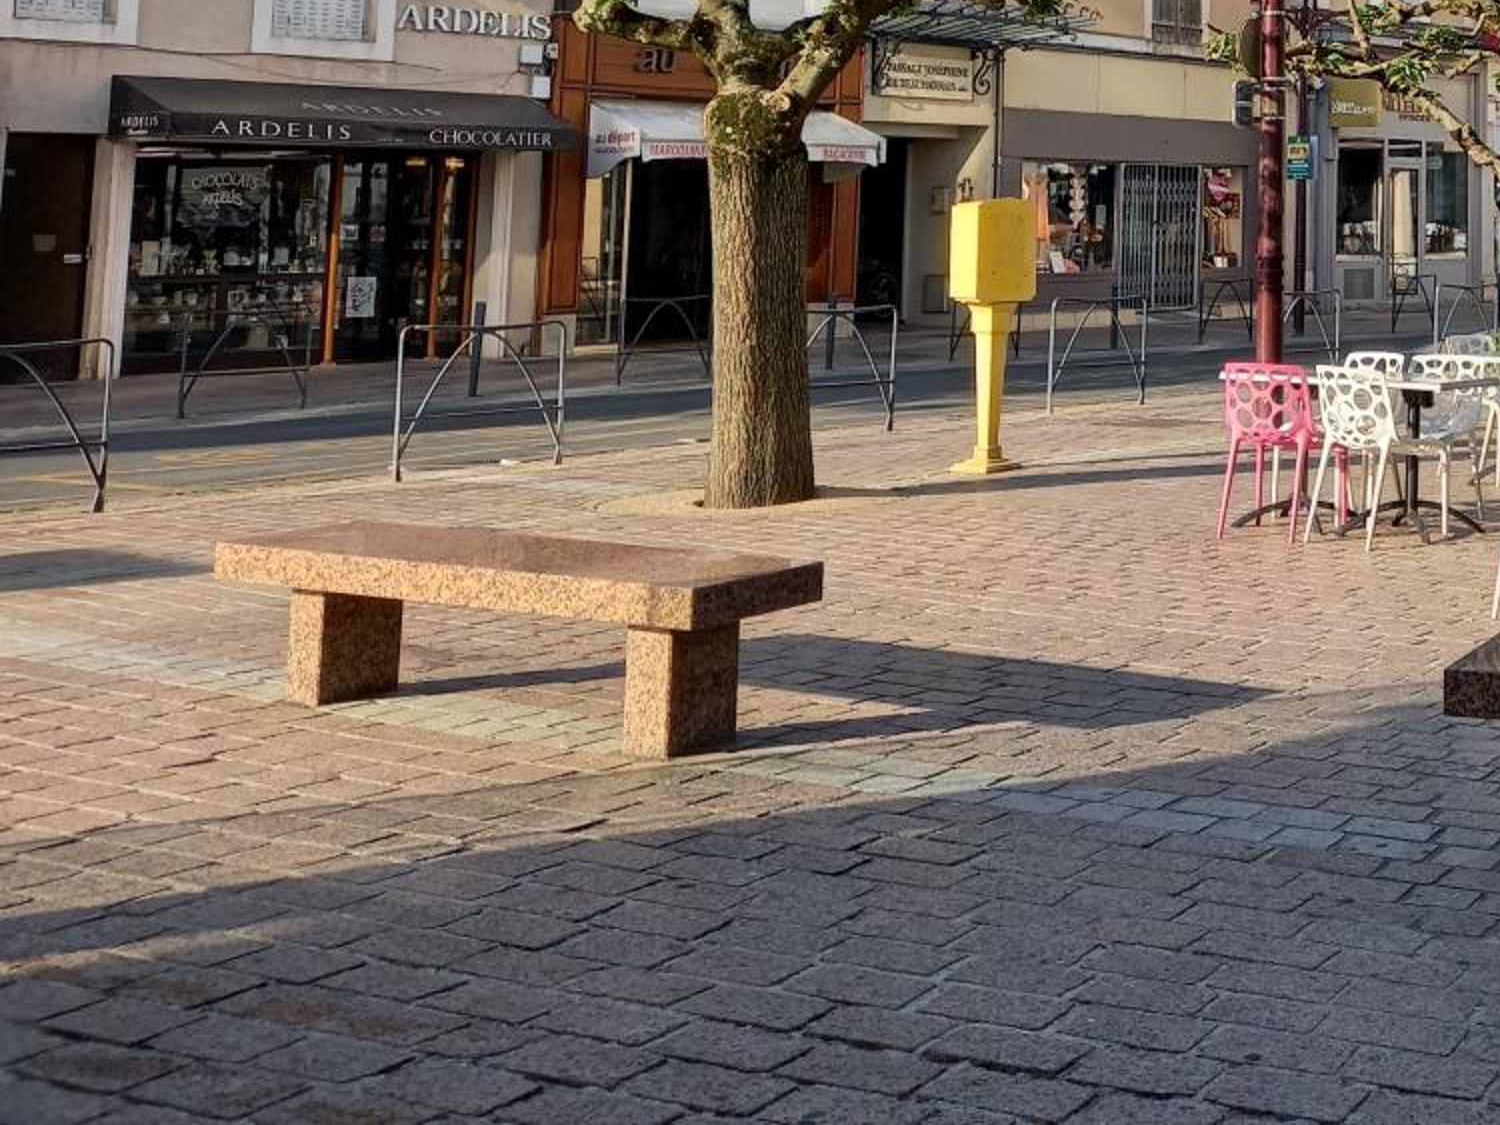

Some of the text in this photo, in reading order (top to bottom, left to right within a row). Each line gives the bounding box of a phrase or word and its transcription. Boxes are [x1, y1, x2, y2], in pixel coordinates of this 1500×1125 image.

[398, 3, 552, 41] ARDELIS
[634, 45, 678, 74] au
[121, 115, 159, 128] ARDELIS
[211, 120, 351, 140] ARDELIS
[429, 128, 551, 146] CHOCOLATIER
